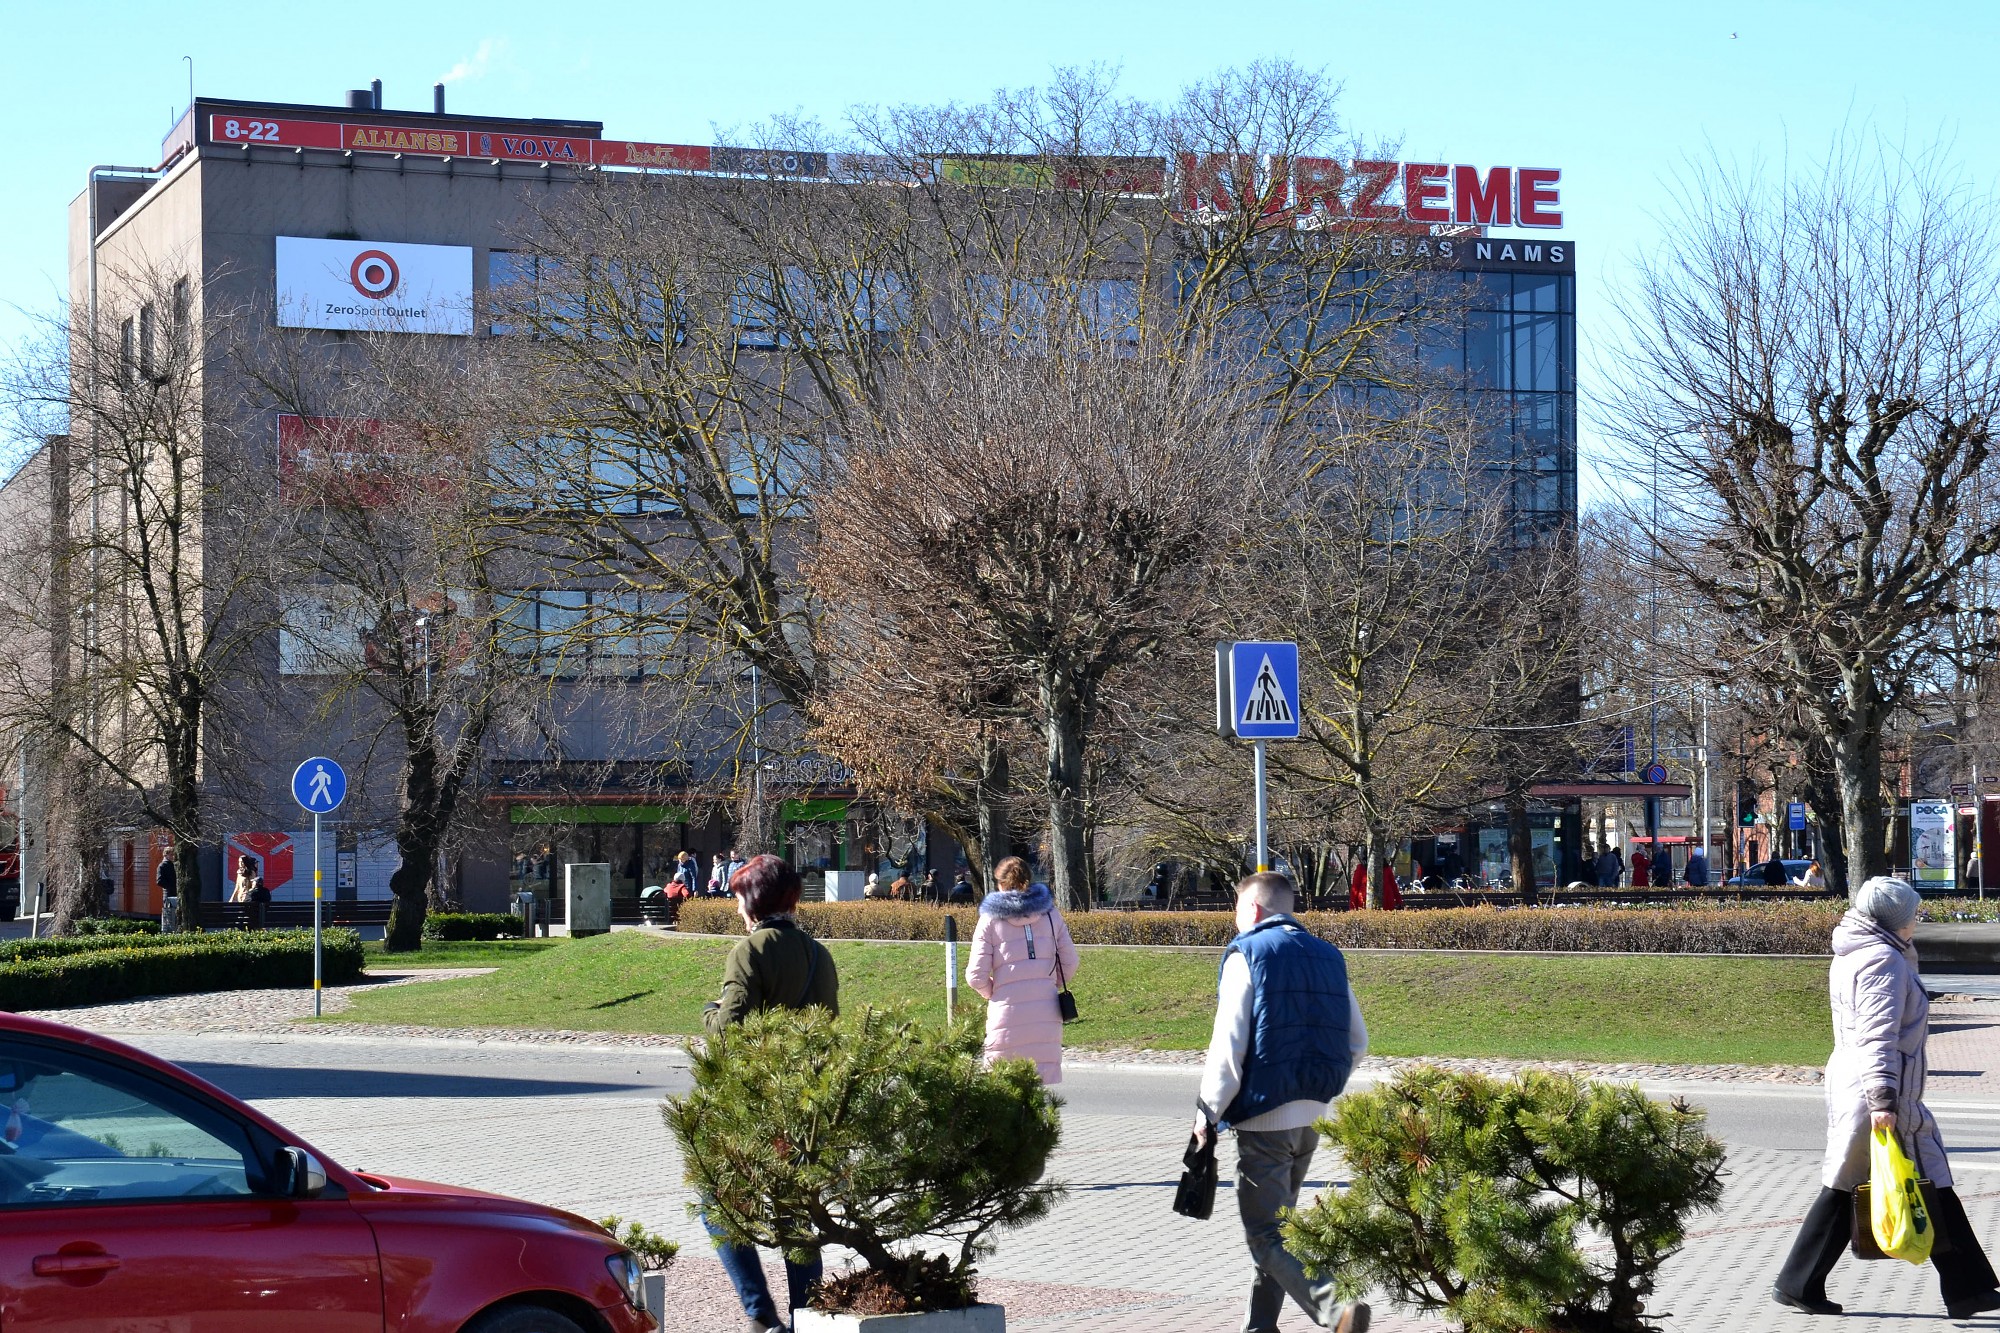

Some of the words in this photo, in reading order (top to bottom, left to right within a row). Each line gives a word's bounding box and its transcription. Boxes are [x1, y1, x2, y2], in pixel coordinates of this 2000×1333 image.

[224, 119, 280, 142] 8-22
[352, 128, 459, 152] ALIANSE
[1176, 150, 1565, 229] KURZEME
[1475, 242, 1566, 264] NAMS
[325, 303, 427, 319] ZeroSportOutlet
[766, 759, 856, 783] RESTO
[1916, 806, 1948, 814] POGA
